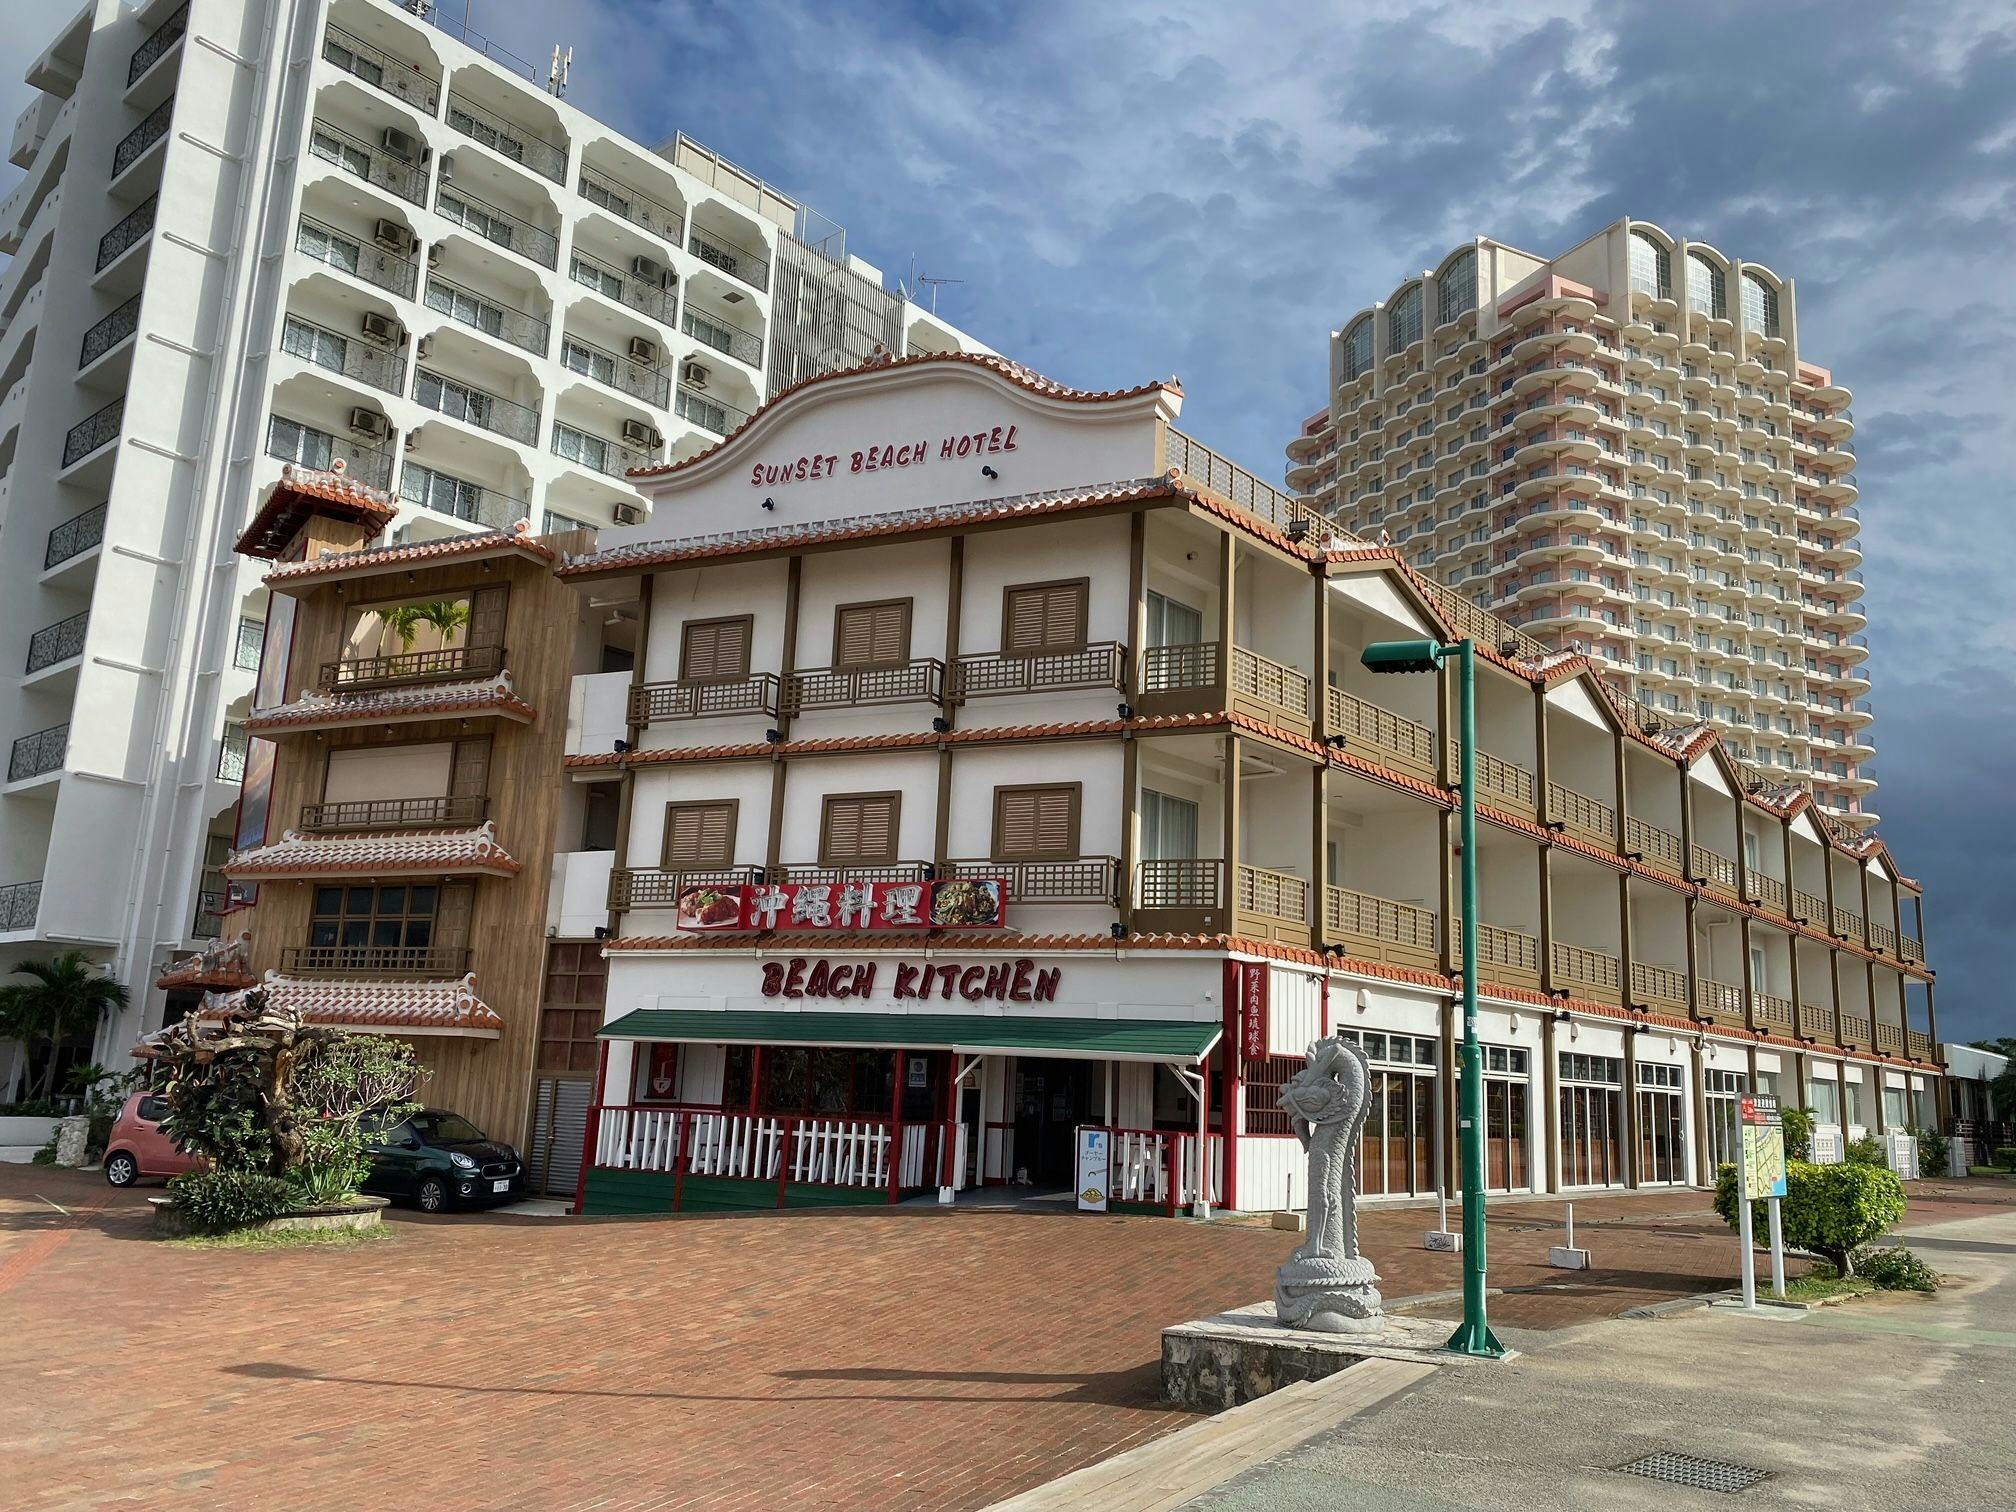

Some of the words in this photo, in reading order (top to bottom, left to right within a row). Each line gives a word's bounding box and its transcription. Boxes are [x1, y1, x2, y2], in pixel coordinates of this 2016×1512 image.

[751, 454, 838, 487] SUNSET
[850, 440, 928, 474] BEACH
[939, 425, 1018, 459] HOTEL
[750, 882, 923, 929] 沖縄料理
[761, 958, 878, 1000] BEACH
[893, 959, 1062, 1002] KITCHEN
